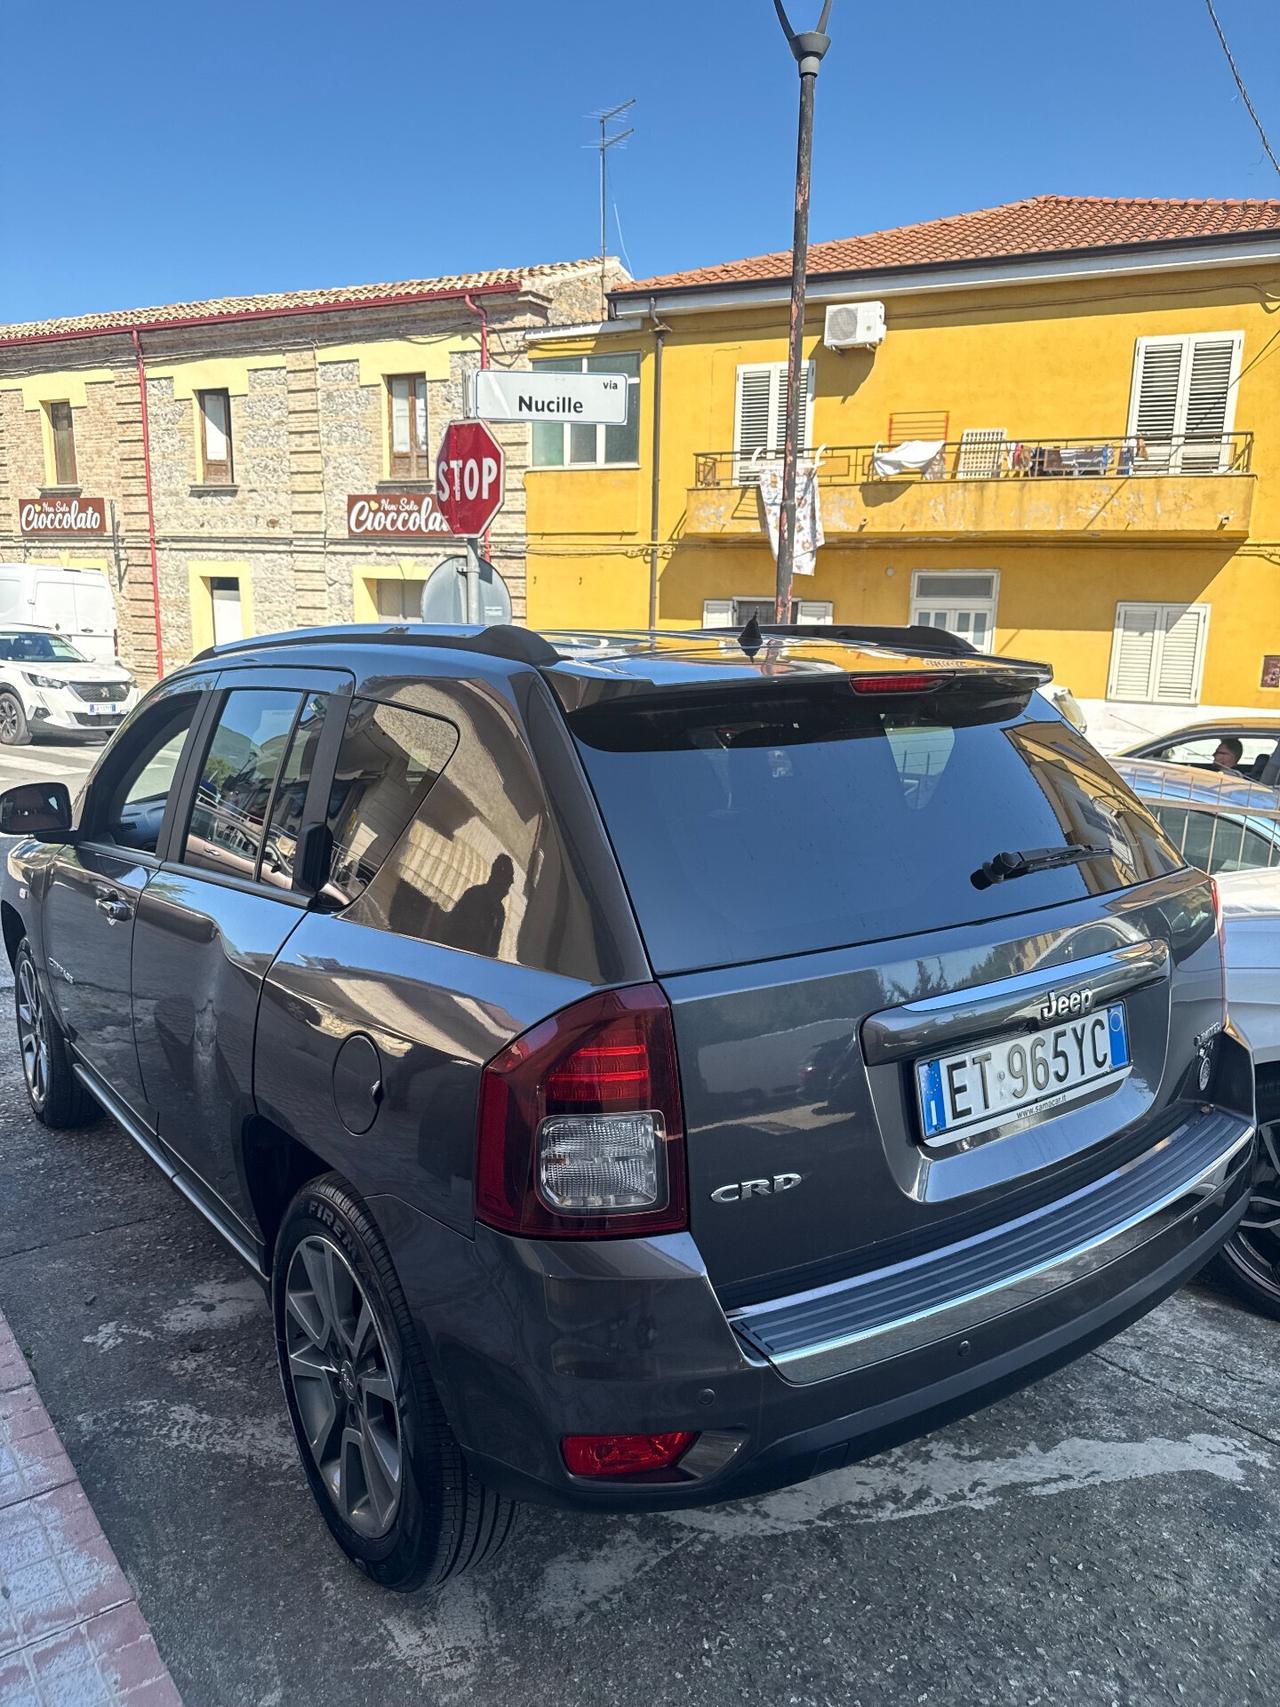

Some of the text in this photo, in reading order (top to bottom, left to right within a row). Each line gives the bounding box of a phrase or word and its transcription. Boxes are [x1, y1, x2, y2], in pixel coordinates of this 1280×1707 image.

[602, 380, 618, 390] via
[518, 395, 584, 413] Nucille
[438, 457, 498, 502] STOP
[21, 500, 101, 531] Cioccolato
[350, 497, 450, 533] Cioccola
[380, 498, 397, 511] Non
[1041, 987, 1094, 1021] Jeep
[1016, 1094, 1067, 1119] www.samacar.it
[710, 1173, 802, 1203] CRD
[307, 1200, 372, 1278] FIREM
